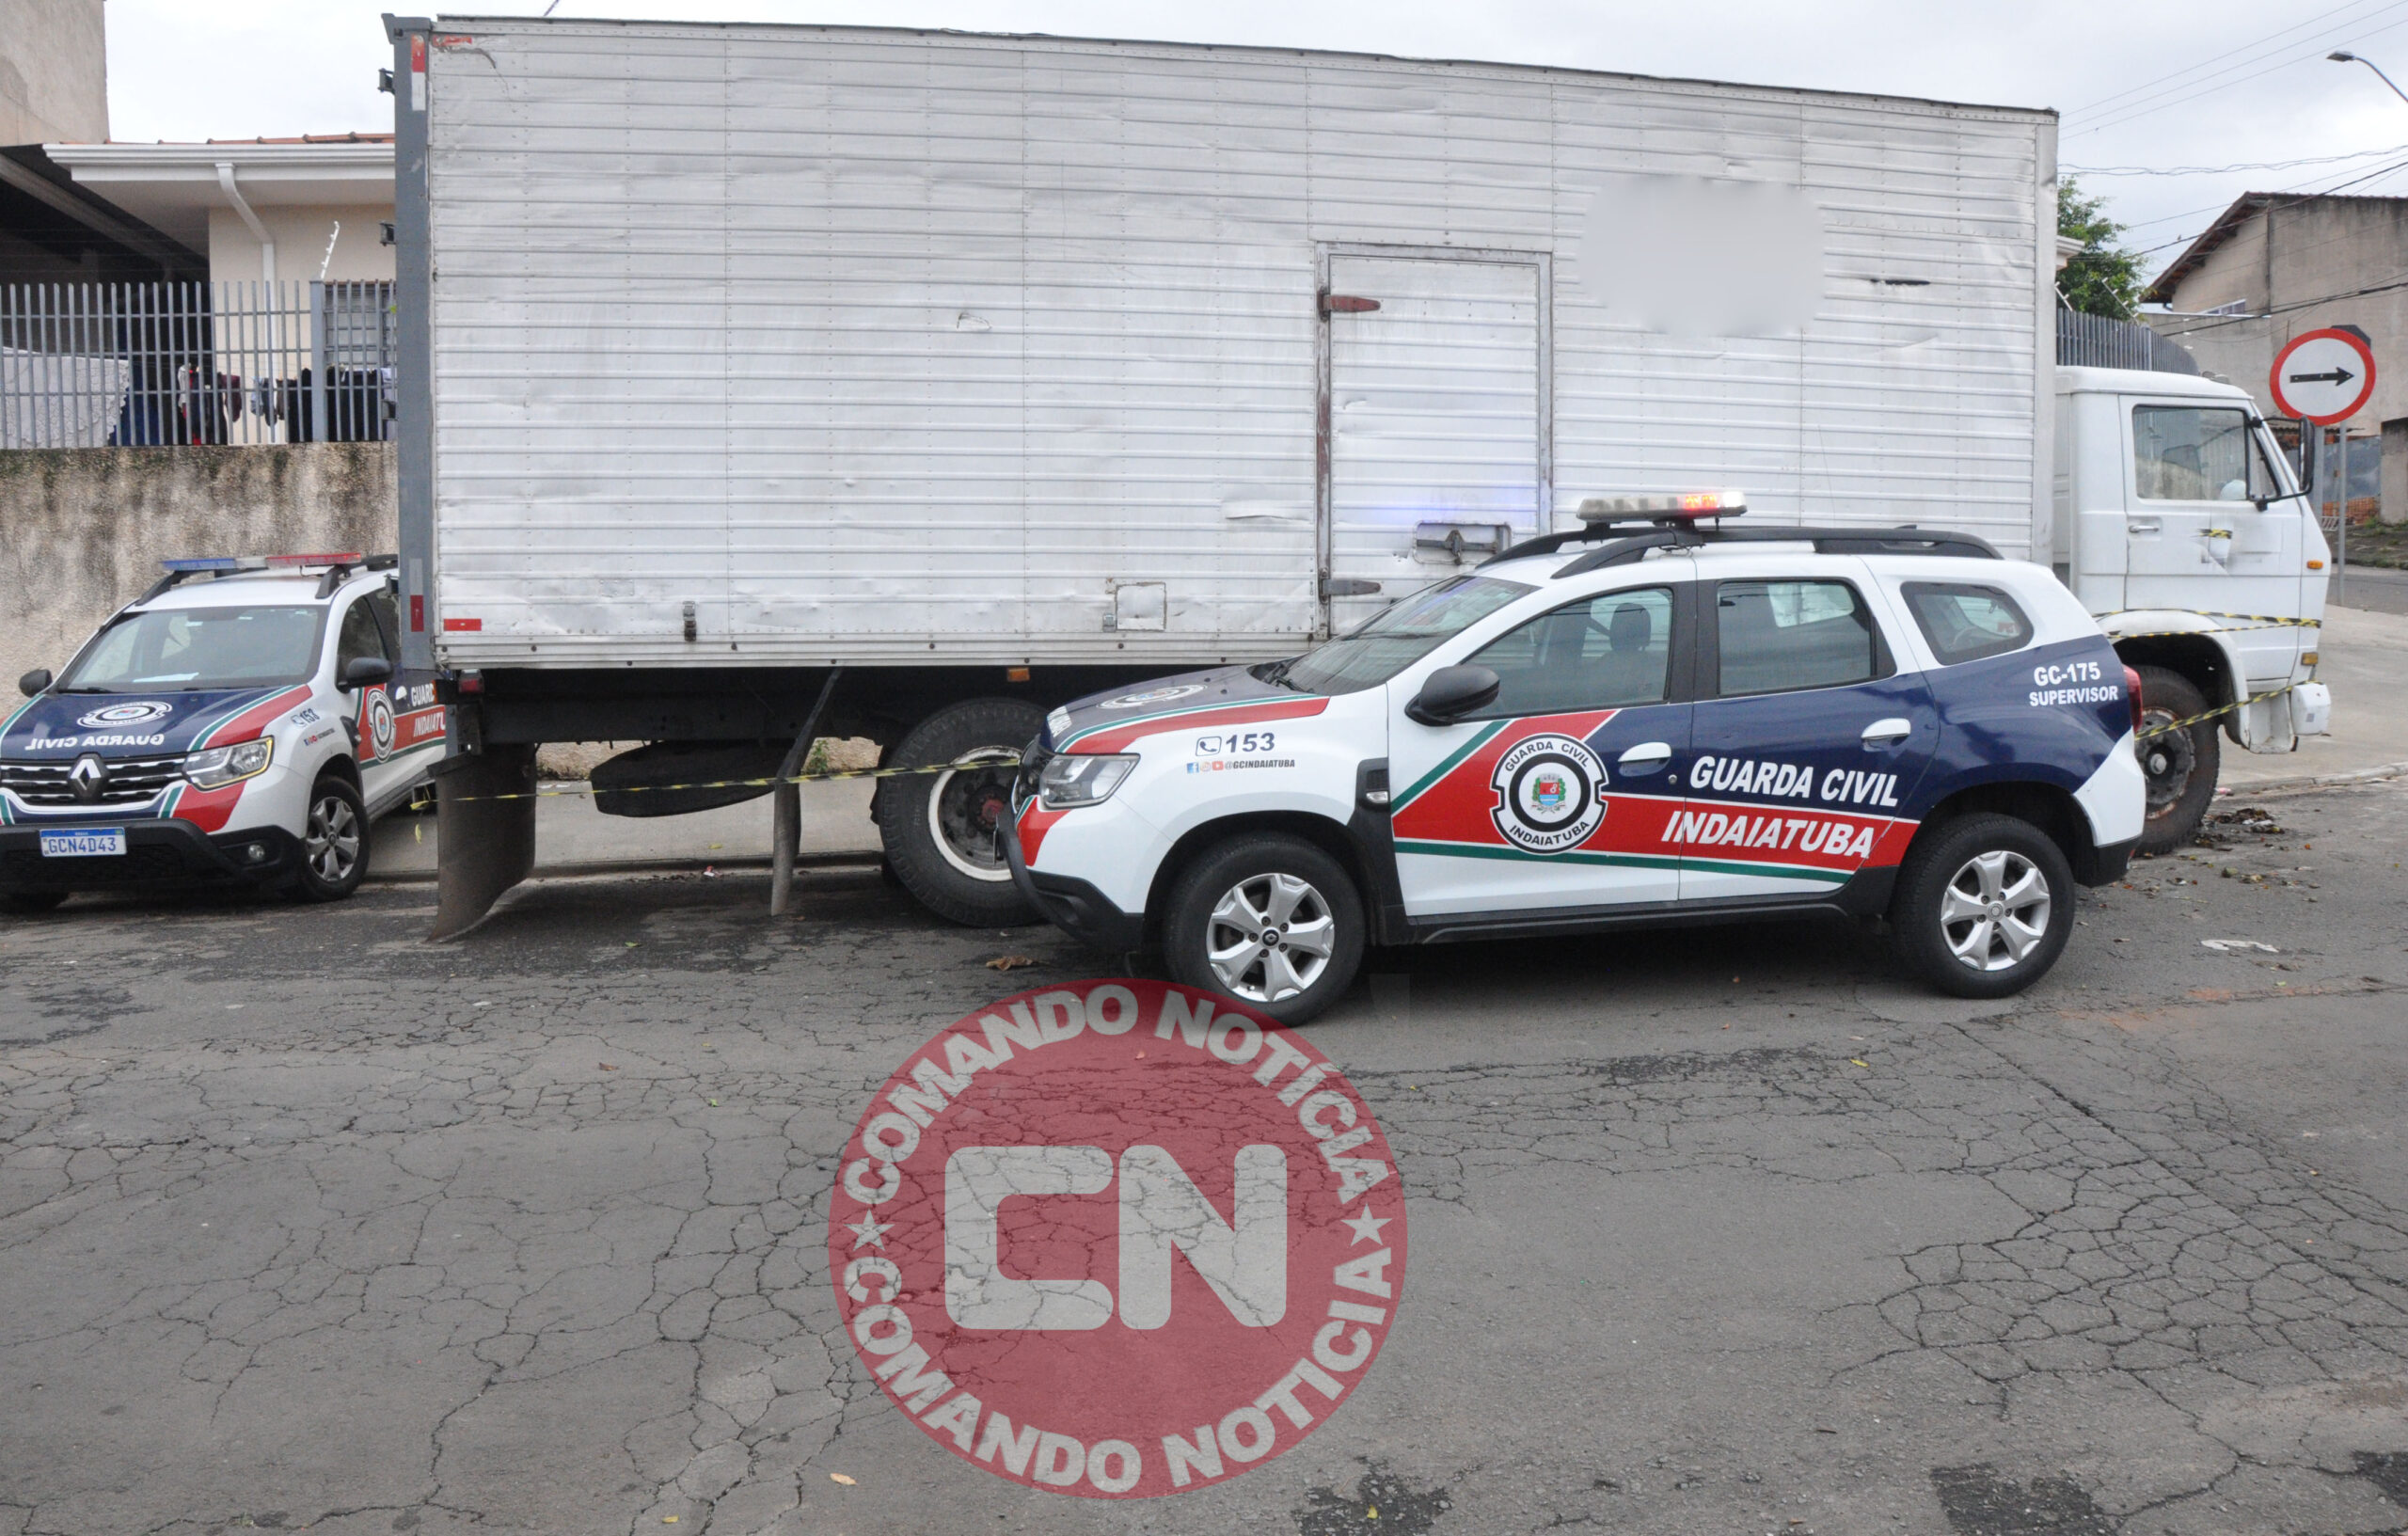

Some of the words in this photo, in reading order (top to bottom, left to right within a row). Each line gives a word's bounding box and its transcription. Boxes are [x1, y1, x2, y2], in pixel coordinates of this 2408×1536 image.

[2034, 661, 2101, 687] GC-175
[411, 683, 435, 706] GUARD
[2029, 685, 2119, 707] SUPERVISOR
[300, 707, 320, 723] 153
[413, 711, 446, 737] INDAIATU
[1226, 732, 1275, 753] 153
[1225, 759, 1295, 770] @GCINDAIATUBA
[1505, 741, 1554, 772] GUARDA
[1561, 743, 1591, 768] CIVIL
[1689, 755, 1814, 799] GUARDA
[1820, 768, 1898, 807] CIVIL
[48, 836, 117, 854] GCN4D43
[1509, 820, 1590, 846] INDAIATUBA
[1661, 810, 1875, 859] INDAIATUBA
